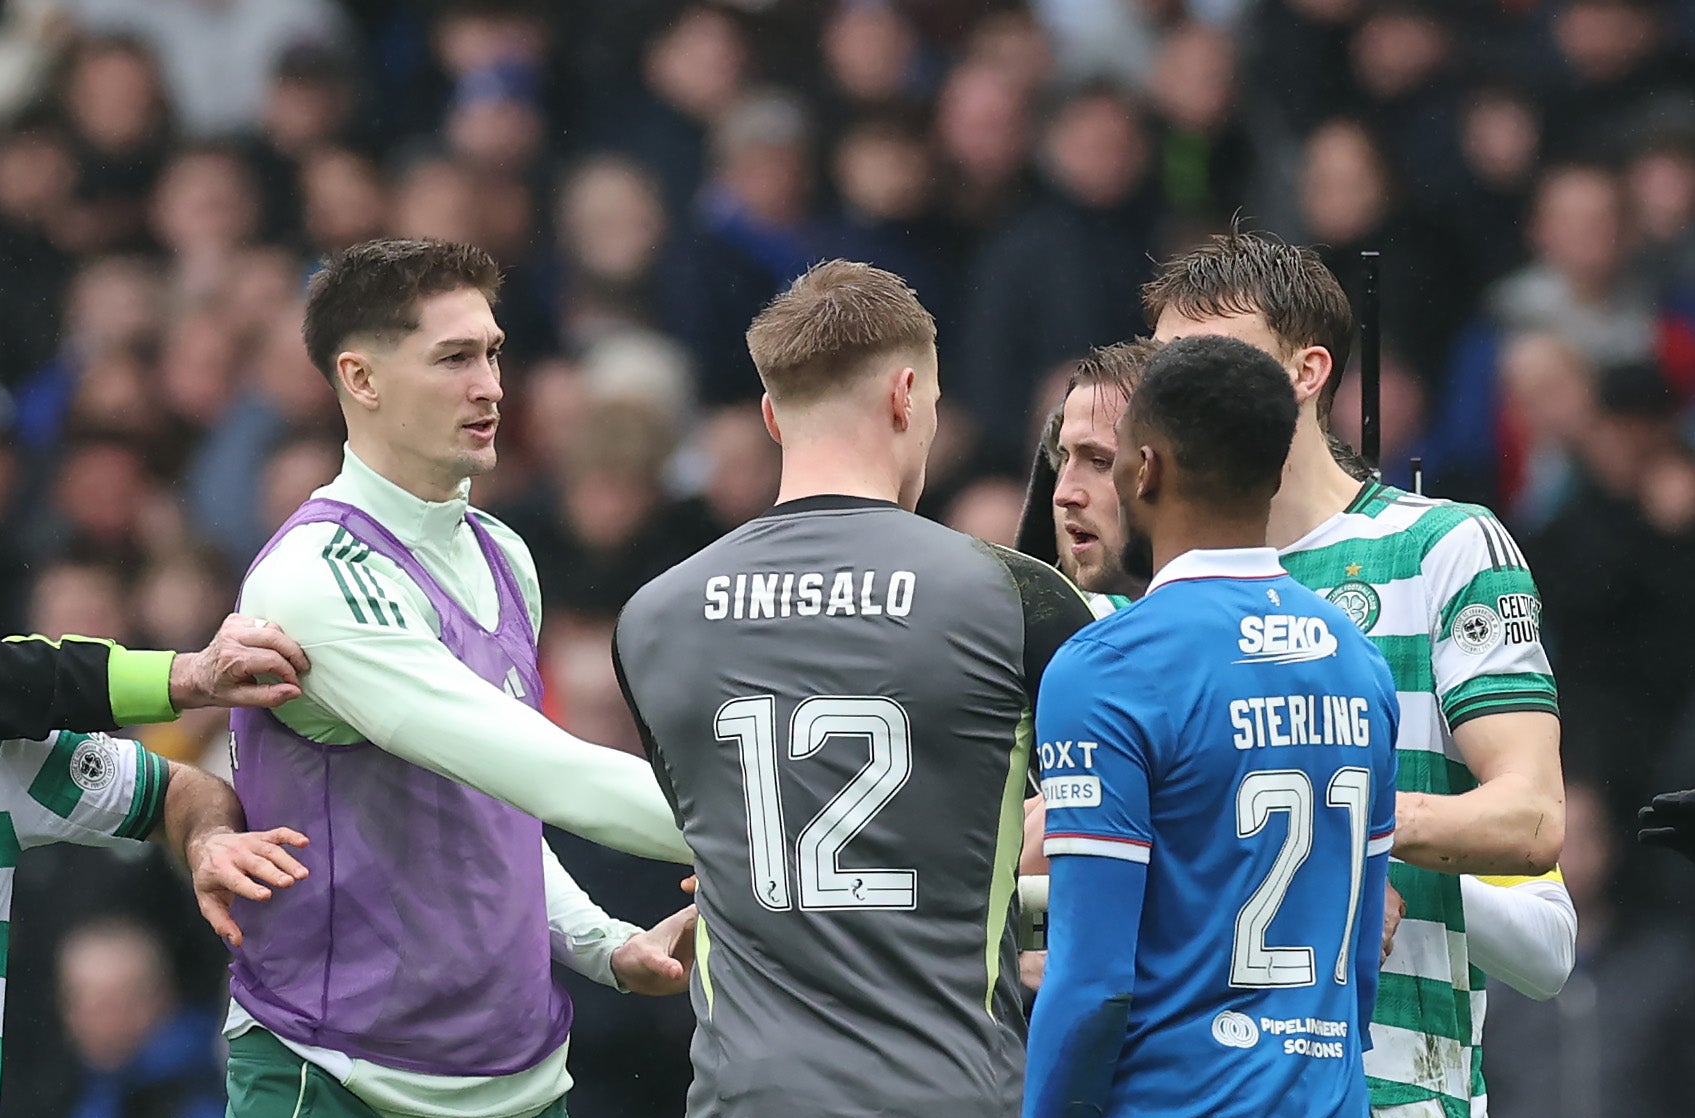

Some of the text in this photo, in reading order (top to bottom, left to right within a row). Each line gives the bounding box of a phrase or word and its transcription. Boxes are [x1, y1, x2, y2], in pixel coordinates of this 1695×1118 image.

[704, 570, 917, 620] SINISALO
[1238, 614, 1338, 656] SEKO
[1229, 695, 1370, 750] STERLING
[1036, 740, 1098, 770] OXT
[713, 694, 917, 912] 12
[1044, 783, 1094, 801] ILERS
[1227, 766, 1370, 989] 21
